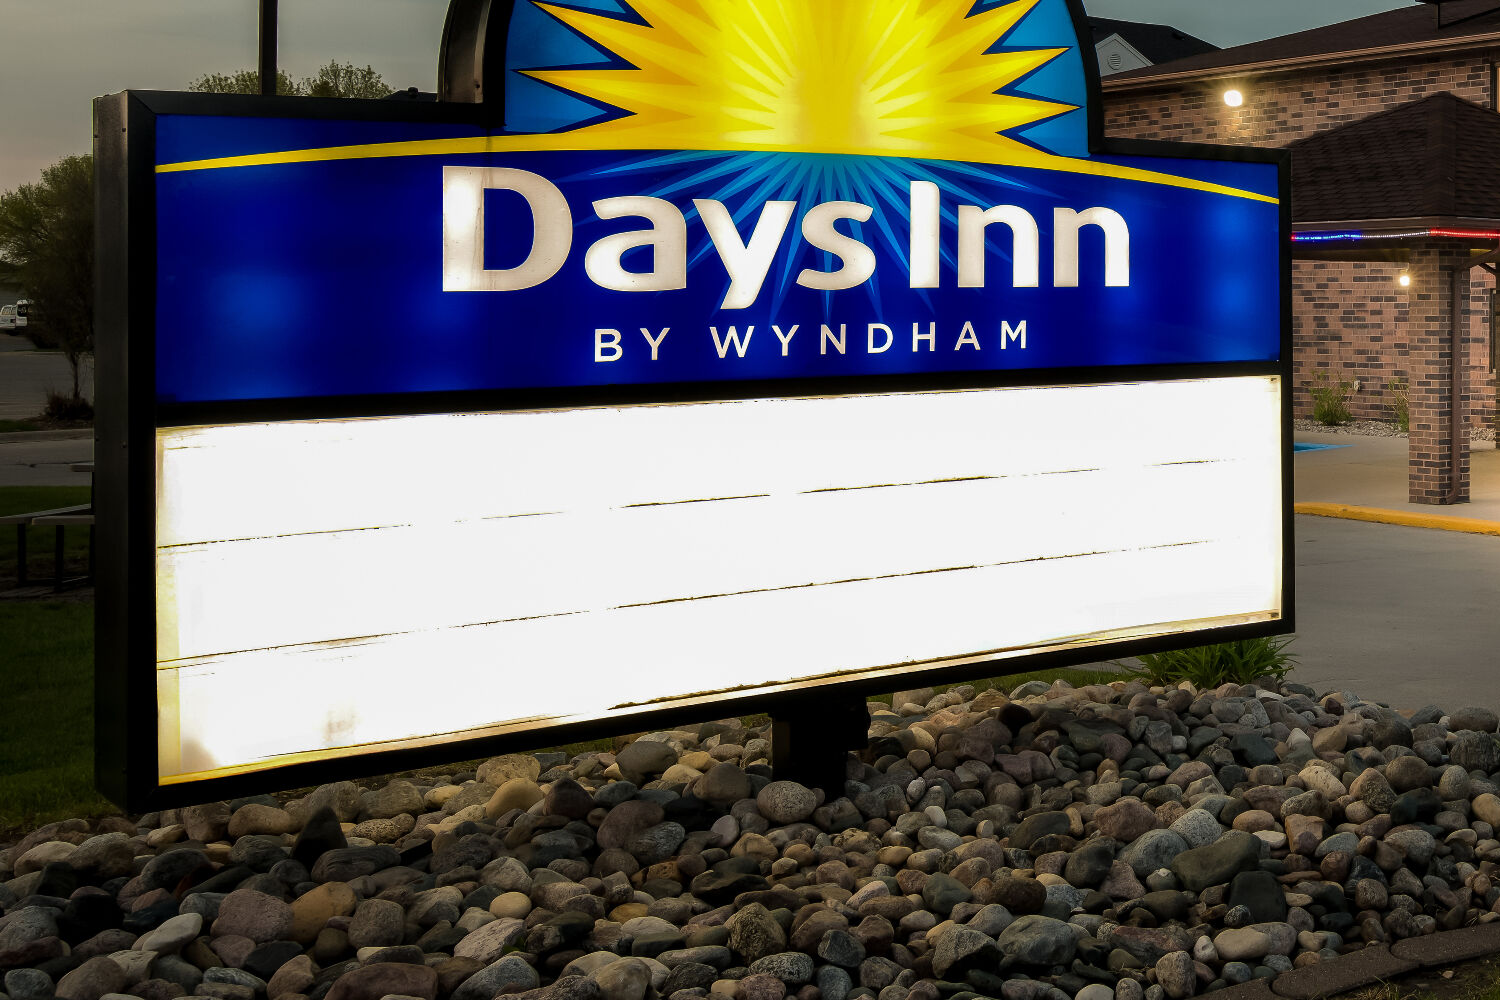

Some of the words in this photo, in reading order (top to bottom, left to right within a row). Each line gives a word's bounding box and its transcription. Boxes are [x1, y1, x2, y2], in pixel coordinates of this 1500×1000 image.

[442, 165, 877, 309] Days
[909, 180, 1130, 289] Inn
[594, 327, 671, 363] BY
[709, 319, 1028, 359] WYNDHAM
